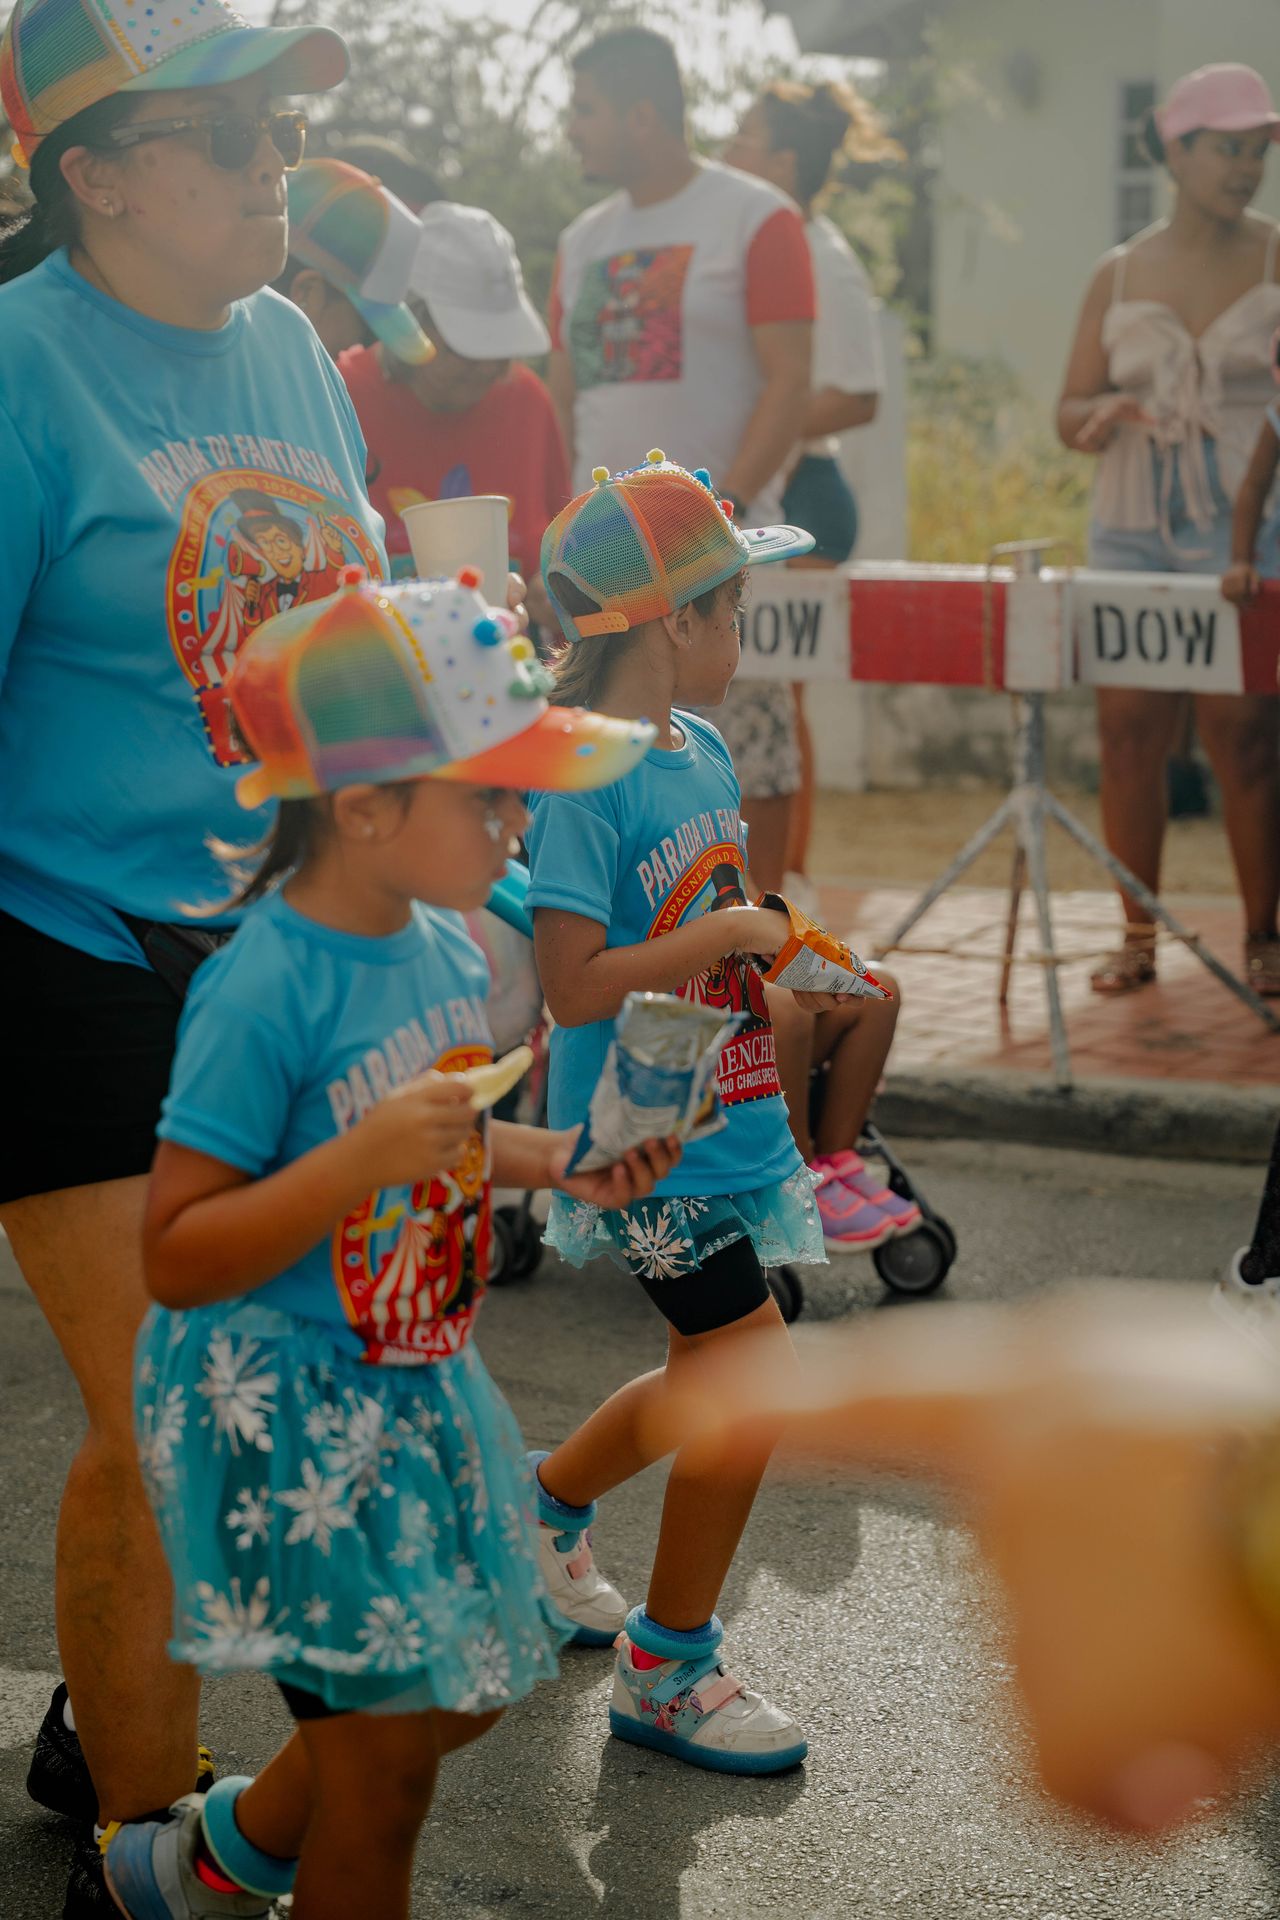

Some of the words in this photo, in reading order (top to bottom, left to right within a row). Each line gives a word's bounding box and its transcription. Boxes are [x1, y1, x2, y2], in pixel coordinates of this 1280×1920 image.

[138, 438, 212, 512] PARADA
[203, 434, 235, 467] DI
[233, 434, 352, 502] FANTASIA
[1094, 604, 1215, 665] DOW
[637, 817, 704, 911] PARADA
[699, 811, 718, 843] DI
[658, 870, 704, 935] AMPAGNE
[702, 851, 730, 873] SQUAD
